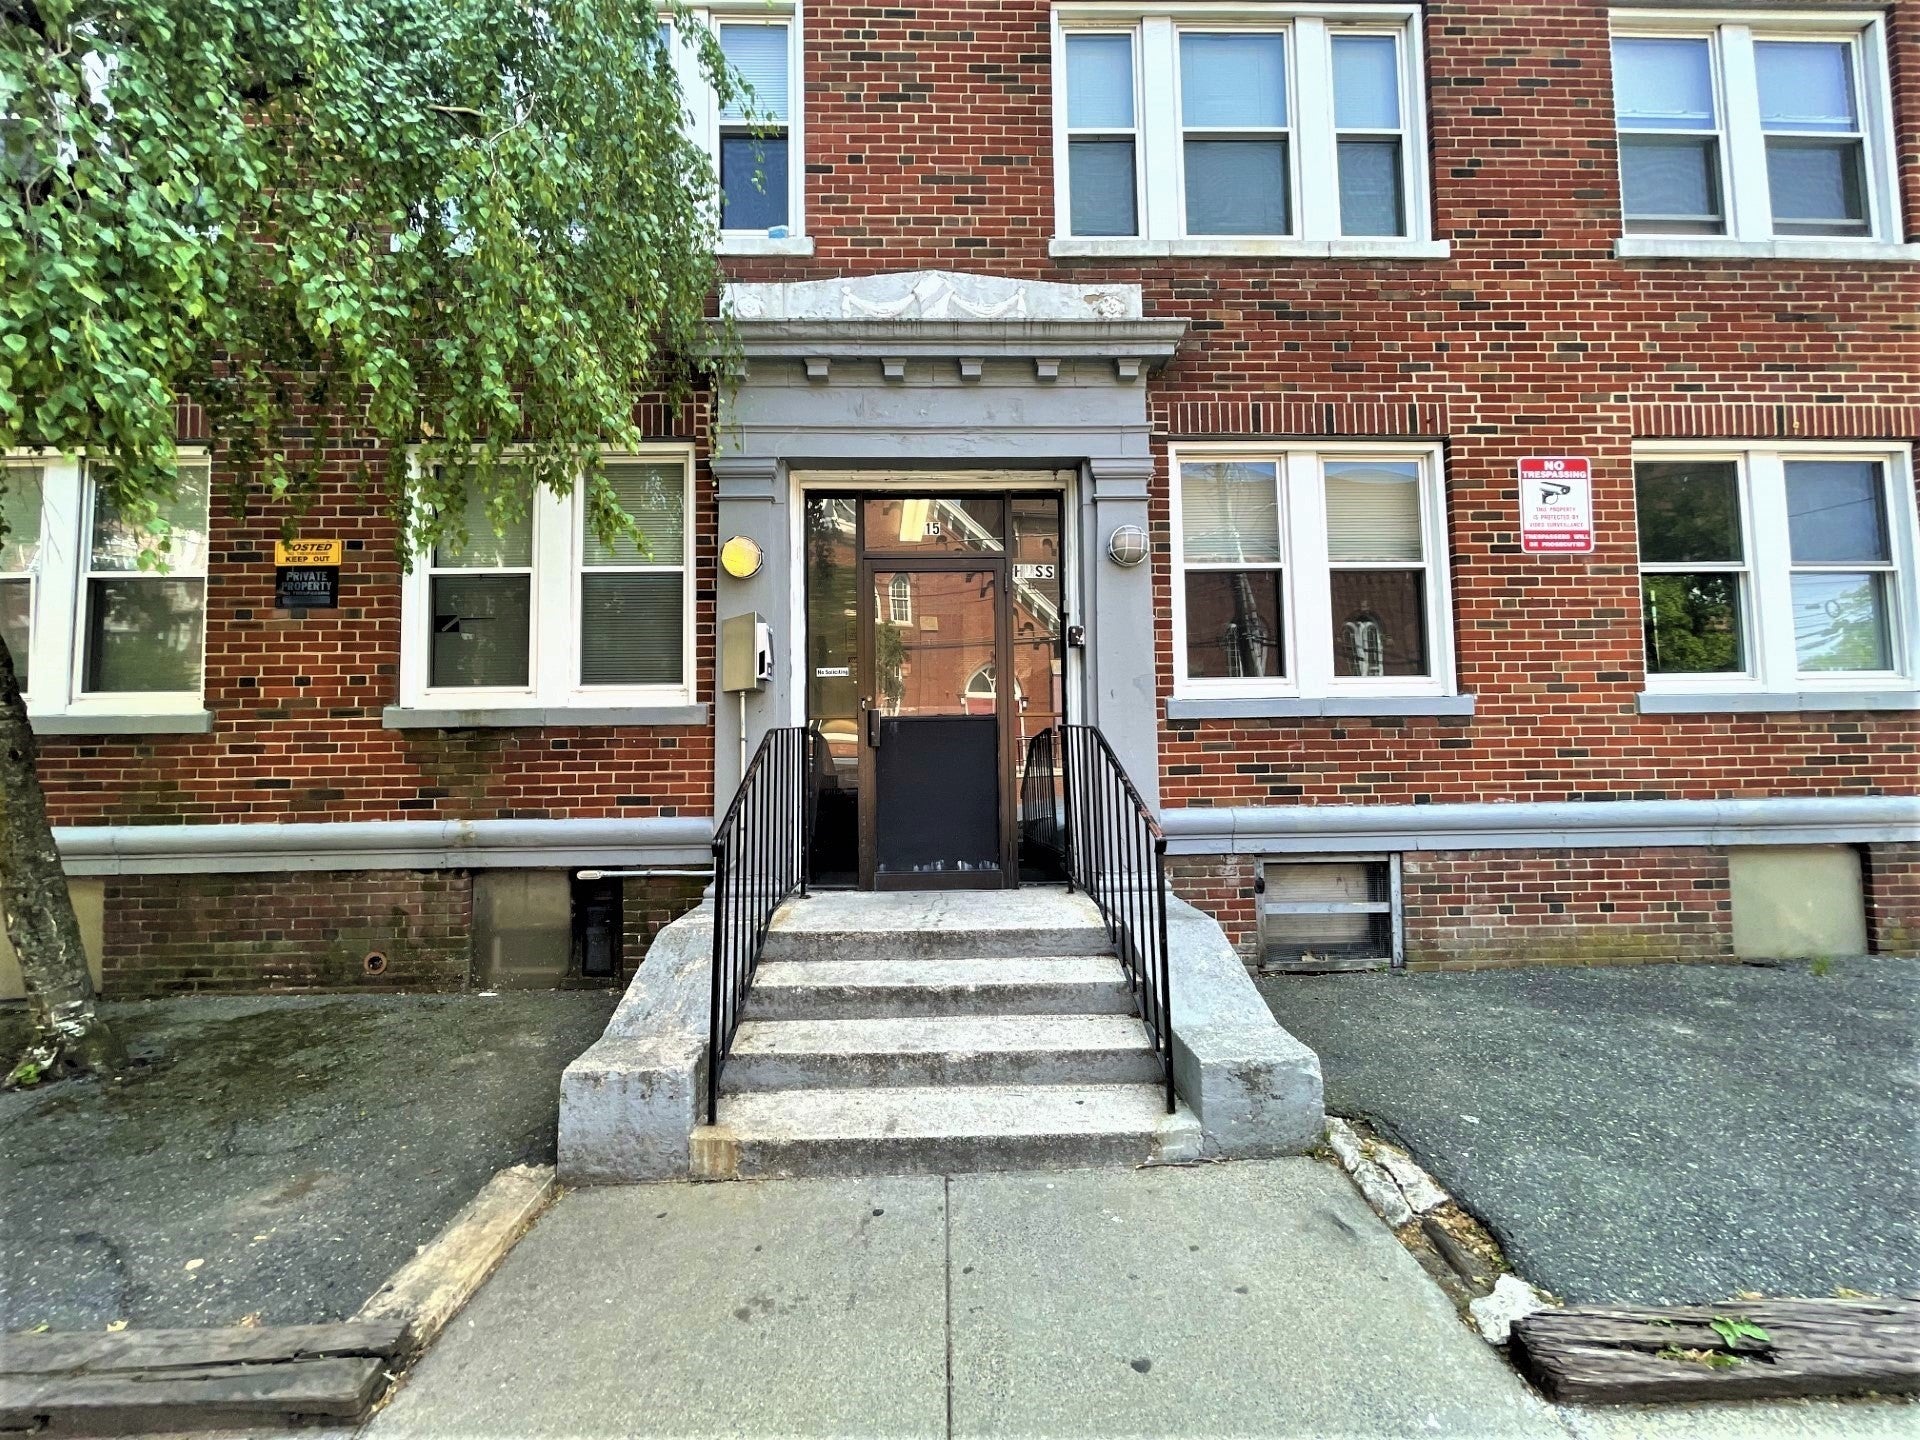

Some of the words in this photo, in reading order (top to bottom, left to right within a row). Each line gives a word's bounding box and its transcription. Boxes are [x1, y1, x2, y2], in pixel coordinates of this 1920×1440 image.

[1543, 460, 1565, 471] NO
[925, 522, 940, 535] 15
[286, 543, 333, 552] OSTED
[285, 555, 309, 563] KEEP
[286, 571, 328, 581] PRIVATE
[281, 581, 332, 591] PROPERTY
